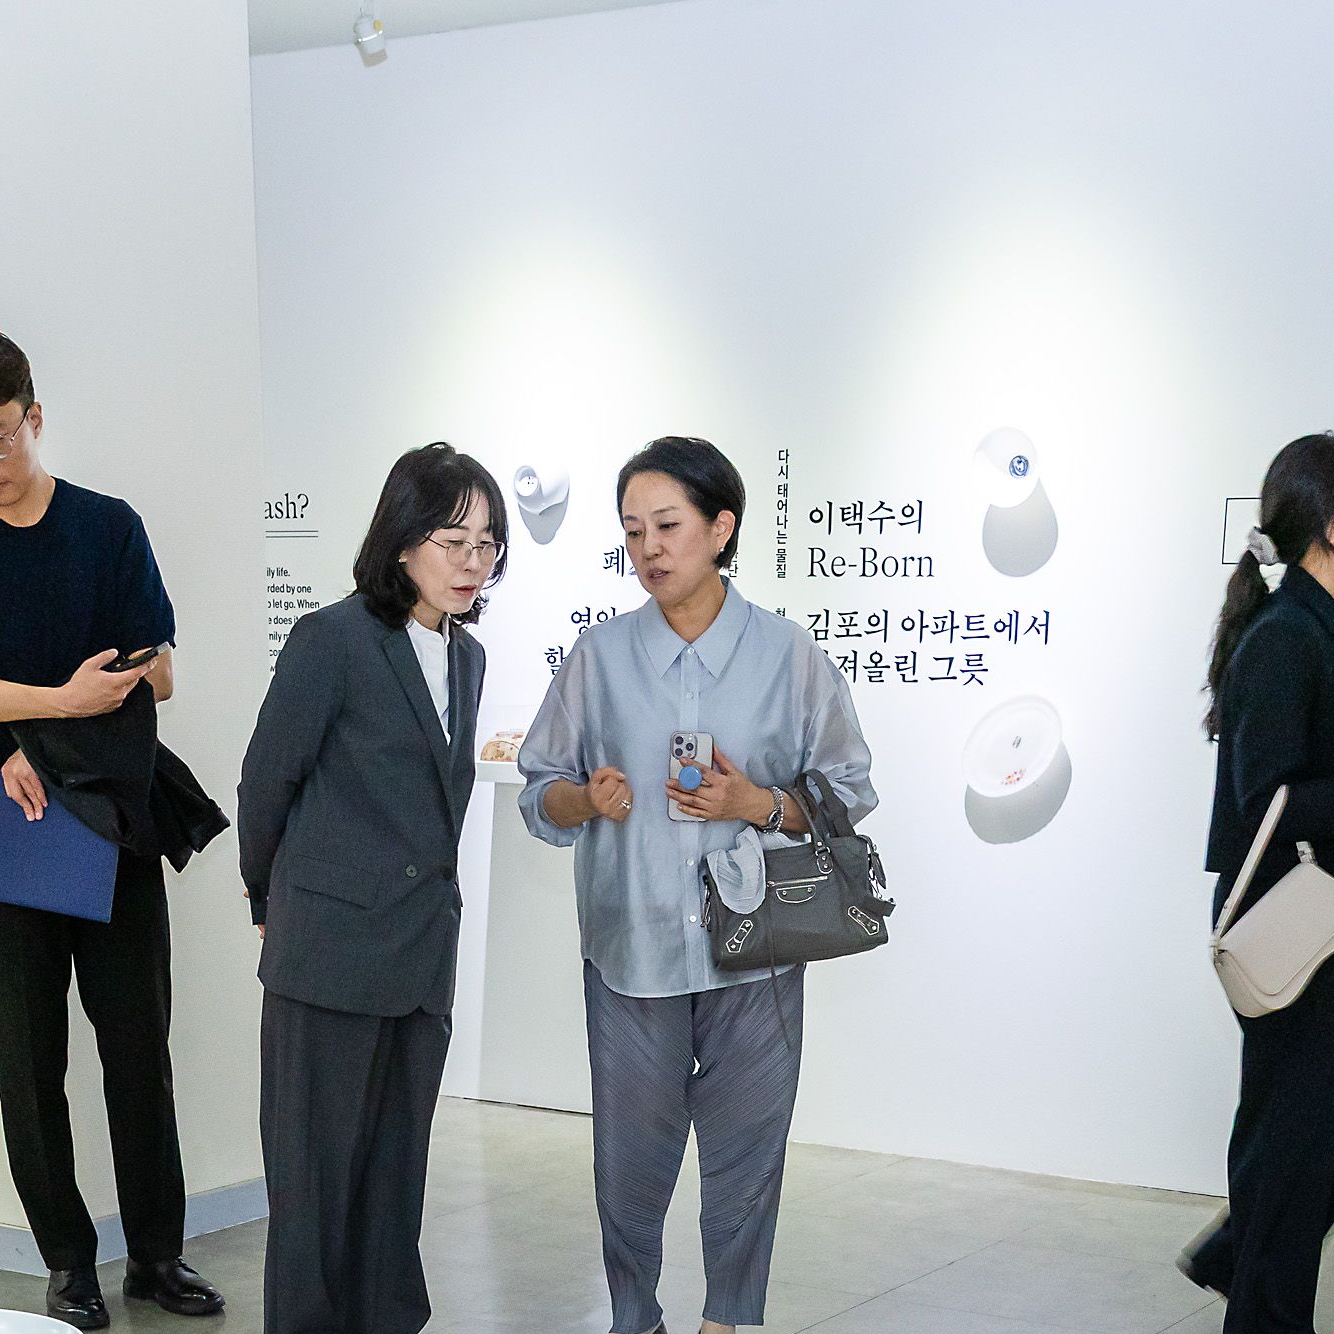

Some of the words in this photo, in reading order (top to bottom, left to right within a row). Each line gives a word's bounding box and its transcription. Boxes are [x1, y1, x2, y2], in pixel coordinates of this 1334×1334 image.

[777, 449, 790, 480] 다시
[265, 492, 309, 520] ash?
[776, 483, 789, 545] 태어나는
[809, 500, 923, 535] 이택수의
[266, 567, 275, 579] ily
[276, 567, 291, 577] life.
[775, 548, 788, 579] 물질
[807, 547, 934, 578] Re-Born
[267, 584, 285, 594] rded
[286, 584, 296, 595] by
[297, 585, 312, 594] one
[273, 599, 283, 609] let
[284, 600, 296, 611] go.
[297, 599, 320, 609] When
[273, 616, 293, 625] does
[807, 608, 889, 644] 김포의
[901, 609, 1050, 645] 아파트에서
[824, 649, 919, 684] 져올린
[929, 654, 988, 686] 그릇
